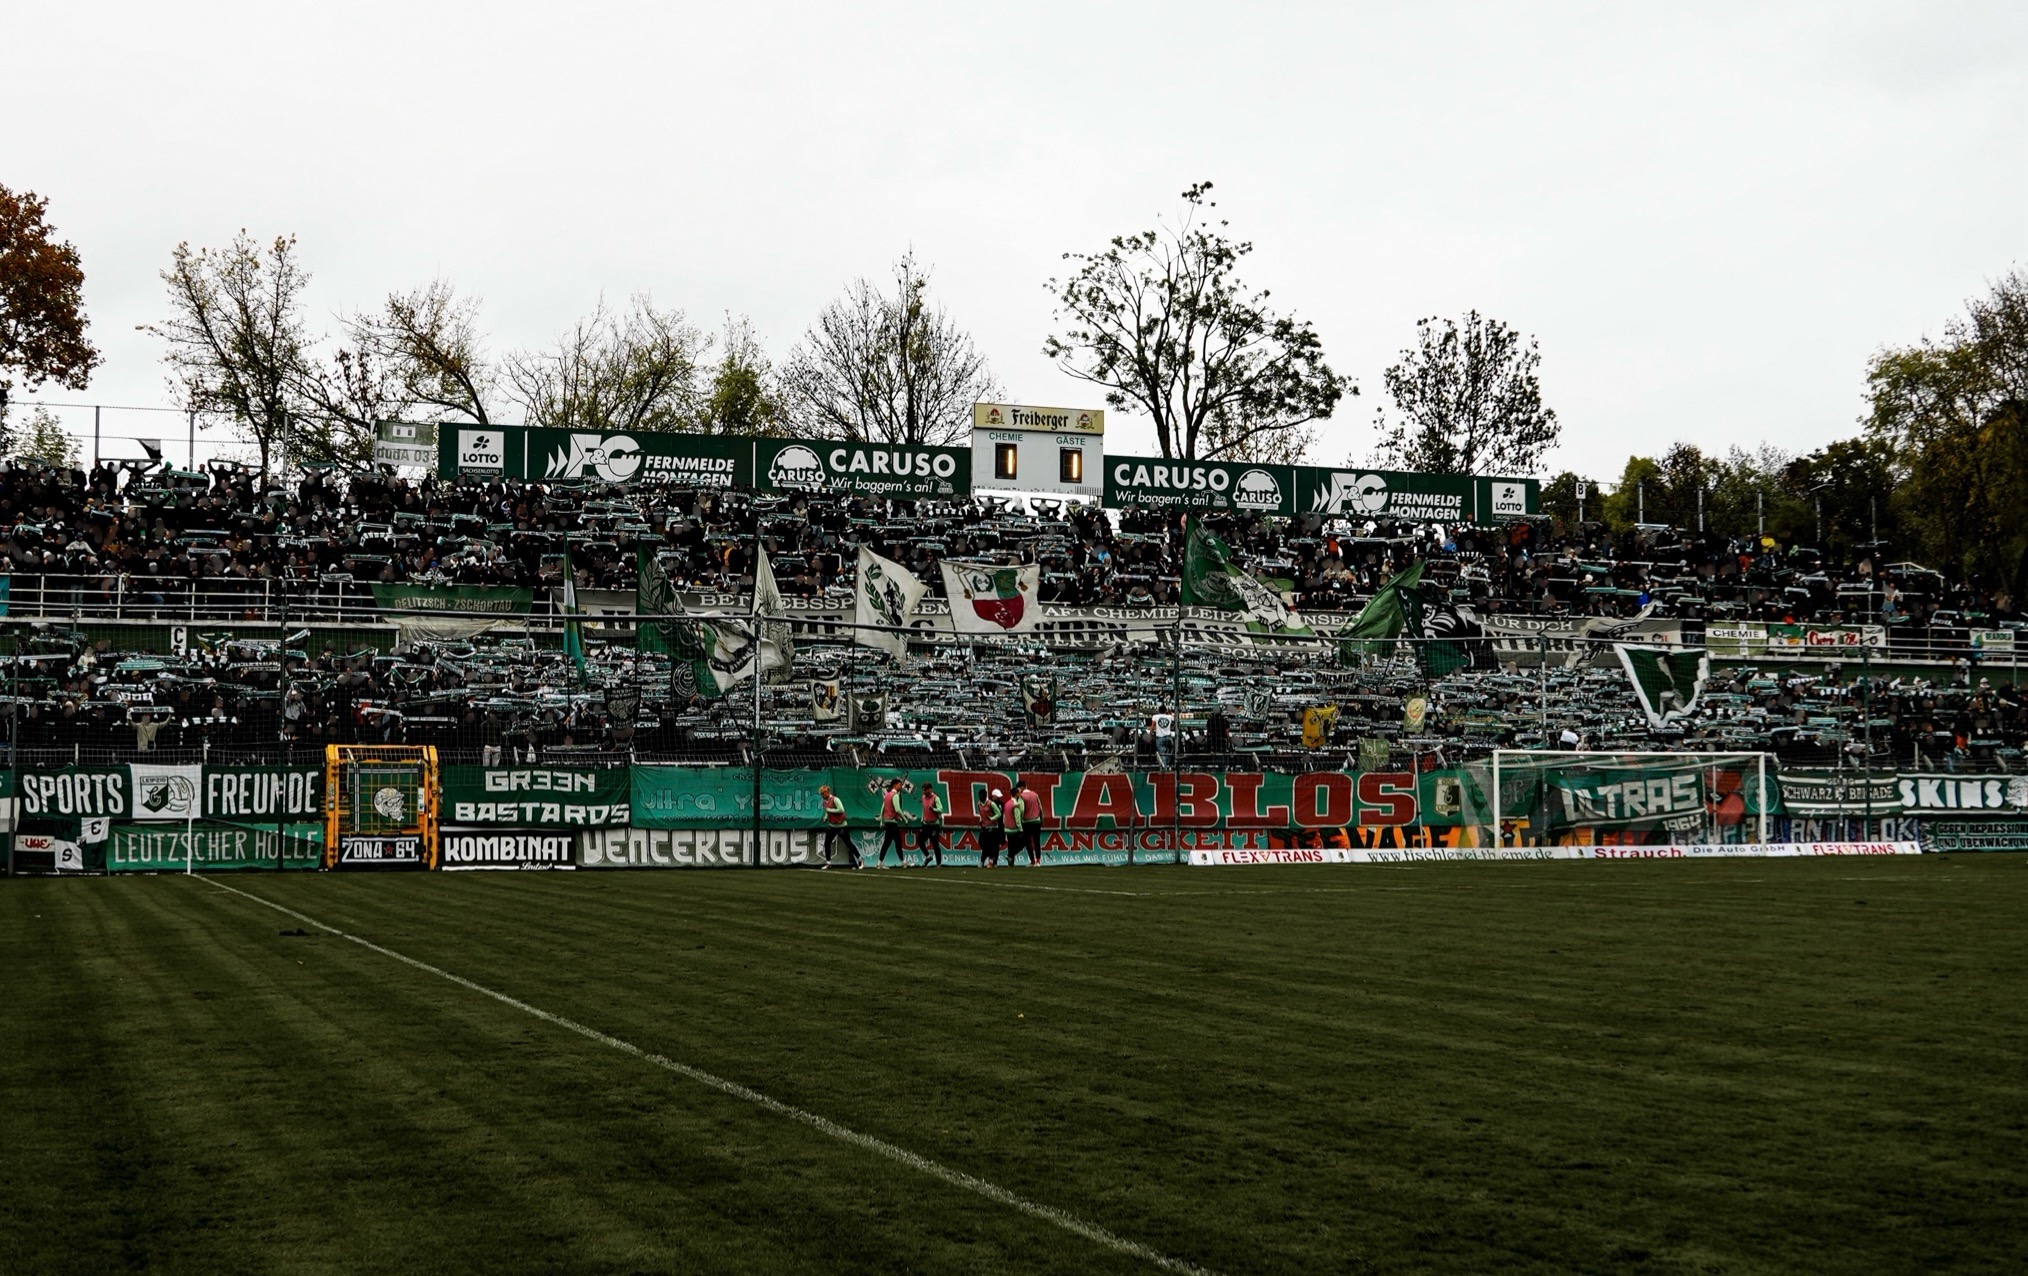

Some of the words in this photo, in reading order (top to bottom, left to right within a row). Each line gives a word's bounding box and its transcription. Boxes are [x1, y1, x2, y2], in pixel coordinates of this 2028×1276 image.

[1011, 409, 1069, 430] Freiberger
[989, 432, 1023, 442] CHEMIE
[1056, 436, 1086, 446] GÄSTE
[462, 453, 499, 464] LOTTO
[645, 455, 735, 472] FERNMELDE
[829, 449, 956, 477] CARUSO
[768, 469, 826, 482] CARUSO
[1114, 463, 1230, 491] CARUSO
[830, 476, 853, 489] Wir
[914, 480, 933, 493] an!
[1115, 490, 1136, 502] Wir
[1232, 491, 1282, 504] CARUSO
[1390, 492, 1462, 507] FERNMELDE
[1388, 506, 1461, 520] MONTAGEN
[1495, 502, 1522, 511] LOTTO
[395, 597, 446, 609] DELITZSCH
[1093, 607, 1179, 620] CHEMIE
[1187, 607, 1244, 622] LEIPZ
[1526, 620, 1573, 631] DICH
[1713, 629, 1760, 638] CHEMIE
[22, 773, 123, 814] SPORTS
[937, 770, 1416, 830] DIABLOS
[1561, 774, 1698, 822] ULTRAS
[1782, 785, 1833, 800] SCHWARZ
[1899, 778, 2003, 808] SKINS
[455, 802, 629, 825] BASTARDS
[1939, 823, 1966, 833] GEGEN
[115, 831, 247, 863] LEUTZSCHER
[342, 840, 383, 861] ZONA
[395, 841, 416, 858] 64
[444, 836, 572, 862] KOMBINAT
[1693, 846, 1713, 854] Die
[1940, 838, 1957, 848] UND
[1367, 847, 1553, 862] www.tischlerei-theme.de
